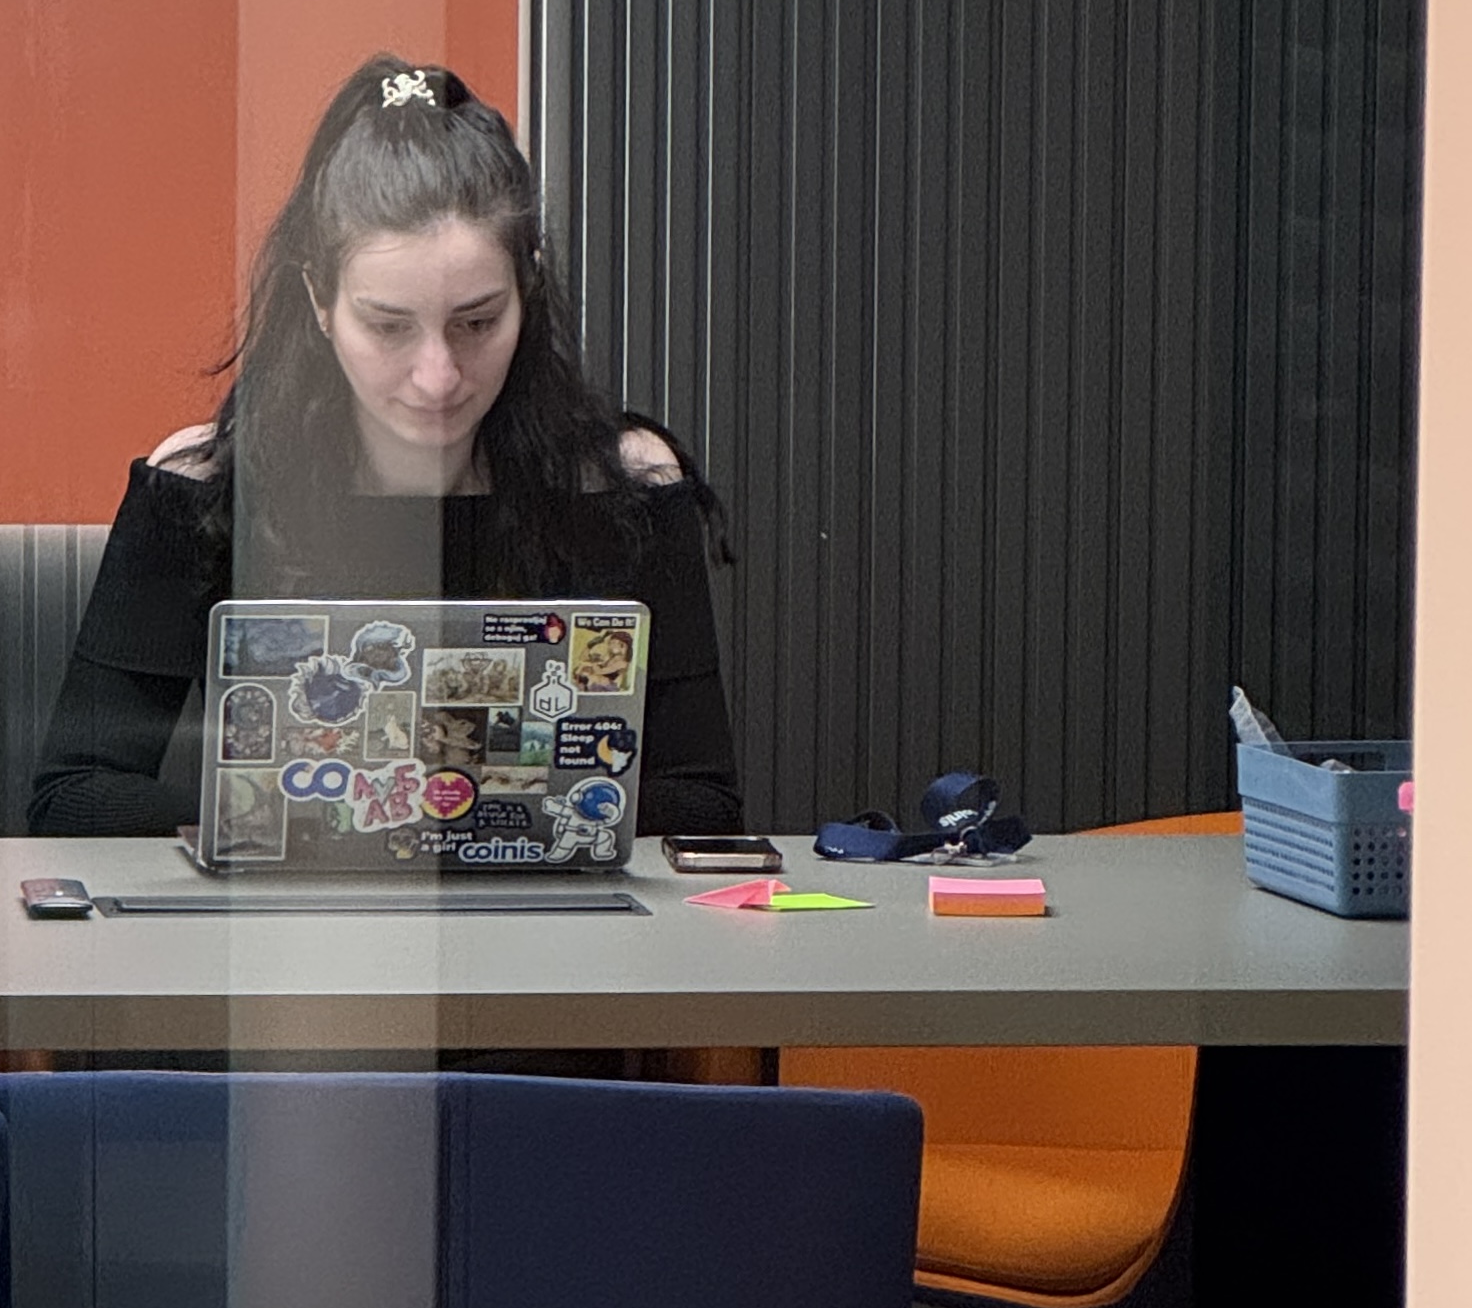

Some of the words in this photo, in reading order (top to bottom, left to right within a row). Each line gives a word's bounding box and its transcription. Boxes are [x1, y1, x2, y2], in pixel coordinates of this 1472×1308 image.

[561, 722, 593, 731] Error
[560, 733, 595, 744] Sleep
[559, 745, 581, 754] not
[558, 756, 596, 766] found
[420, 830, 443, 841] I'm
[445, 830, 473, 842] just
[432, 841, 457, 854] girl
[462, 838, 544, 861] coinis
